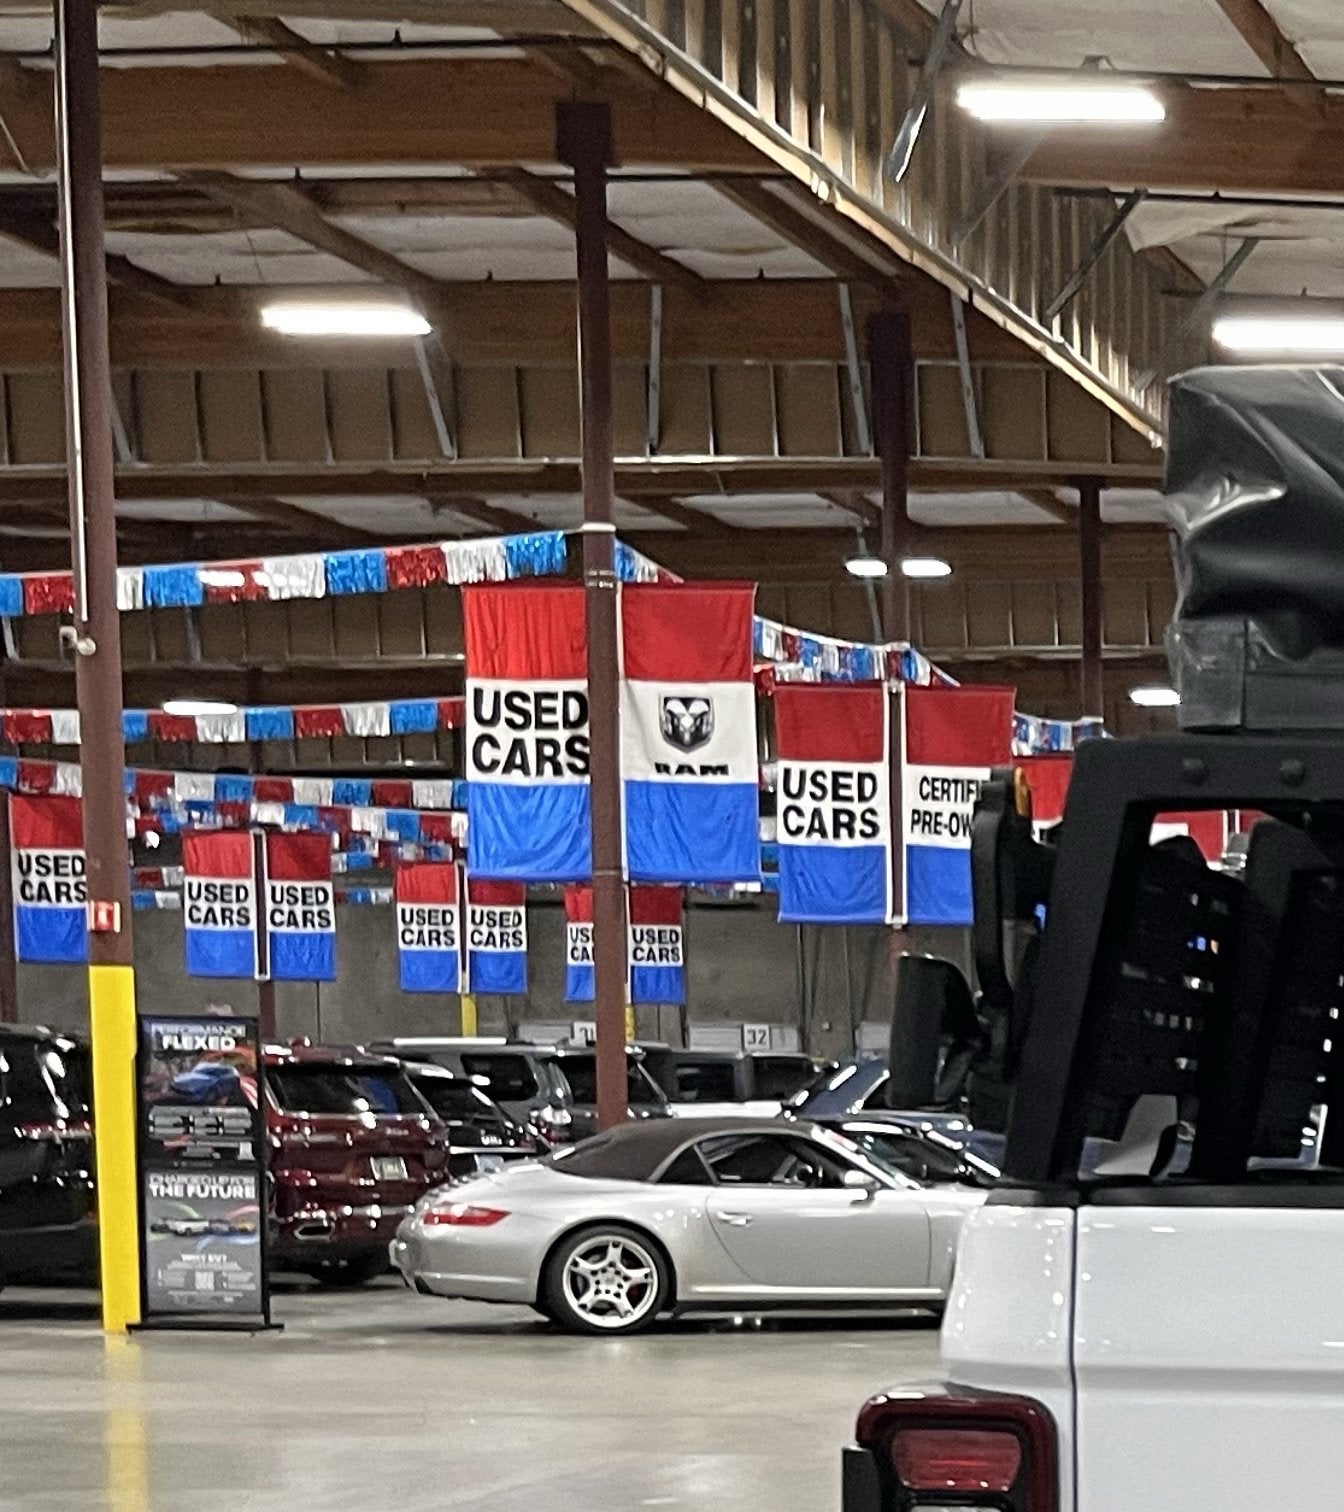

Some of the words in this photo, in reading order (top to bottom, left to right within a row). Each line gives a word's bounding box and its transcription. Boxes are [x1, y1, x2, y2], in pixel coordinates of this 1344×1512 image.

[473, 687, 588, 730] USED
[472, 733, 589, 777] CARS
[783, 768, 878, 803] USED
[782, 804, 880, 840] CARS
[18, 855, 85, 877] USED
[20, 880, 87, 903] CARS
[188, 881, 249, 904] USED
[270, 884, 329, 907] USED
[188, 904, 250, 928] CARS
[269, 908, 331, 929] CARS
[400, 908, 454, 927] USED
[470, 909, 522, 929] USED
[400, 929, 455, 947] CARS
[470, 929, 523, 949] CARS
[570, 926, 593, 943] US
[632, 926, 679, 944] USED
[570, 946, 593, 962] CA
[632, 946, 680, 962] CARS
[149, 1184, 184, 1198] THE
[187, 1184, 255, 1199] FUTURE
